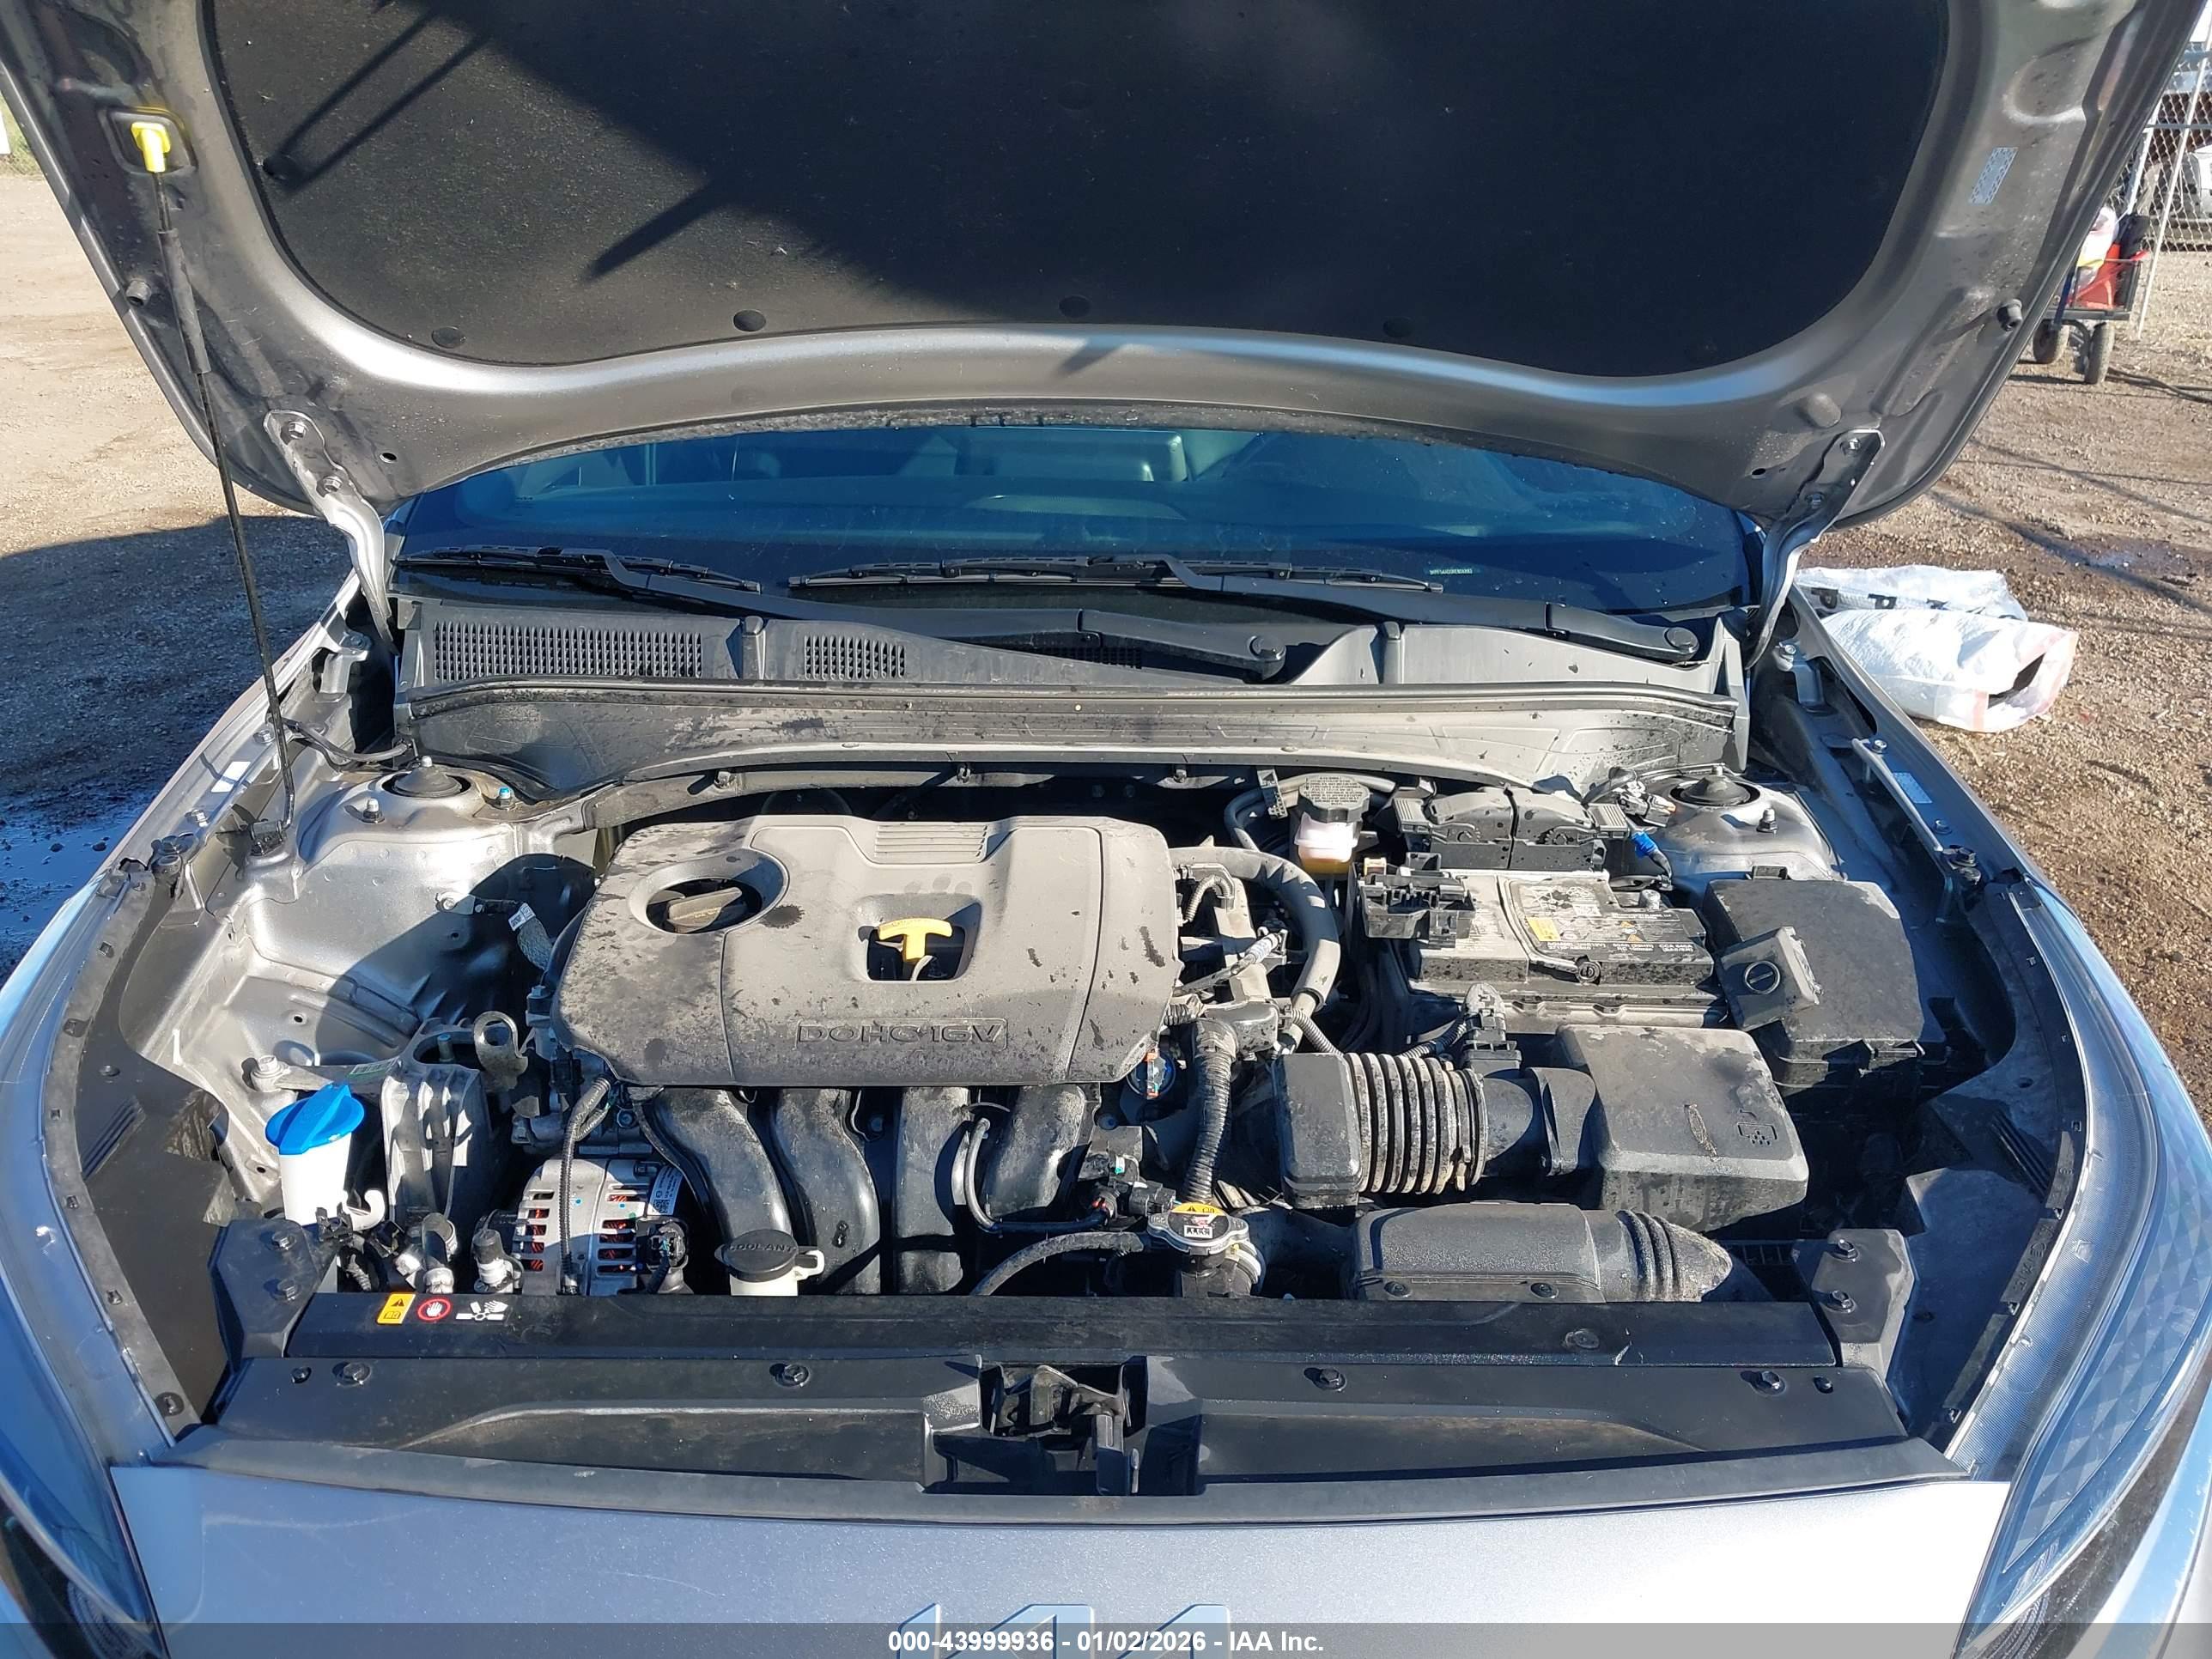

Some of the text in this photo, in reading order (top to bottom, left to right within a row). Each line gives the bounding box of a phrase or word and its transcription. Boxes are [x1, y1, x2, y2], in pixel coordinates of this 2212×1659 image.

[798, 1024, 1004, 1043] DOHC 16V
[729, 1243, 797, 1253] COOLANT
